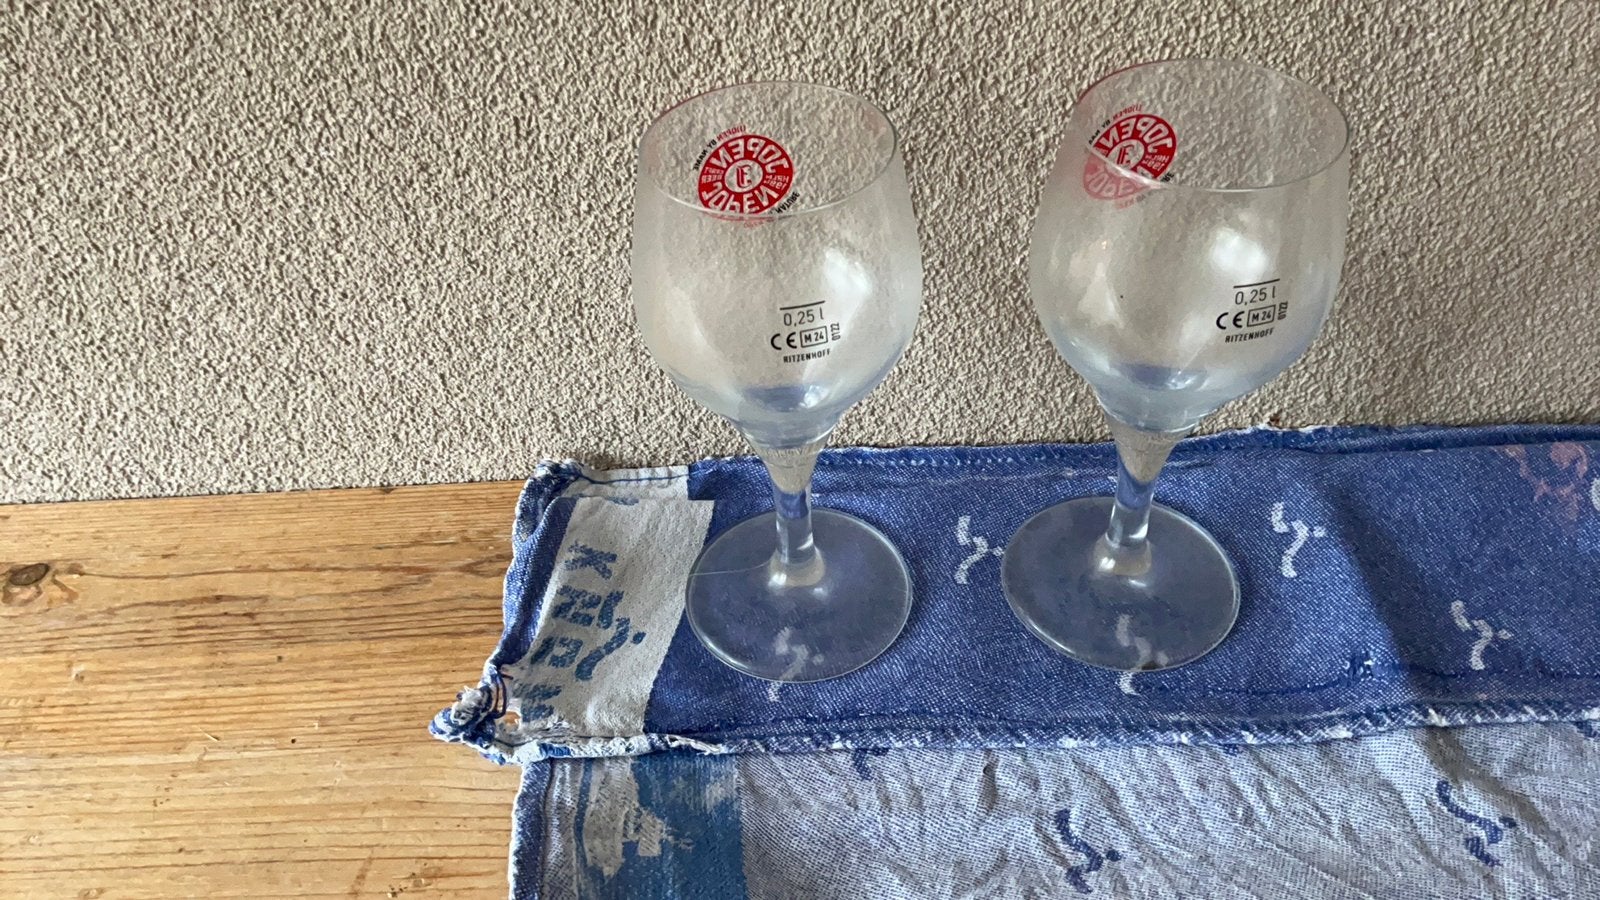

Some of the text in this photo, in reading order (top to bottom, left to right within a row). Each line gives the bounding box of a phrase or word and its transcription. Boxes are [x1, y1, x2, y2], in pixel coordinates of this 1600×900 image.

[1234, 287, 1267, 306] 0,25
[783, 309, 815, 327] 0,25
[1216, 310, 1245, 330] CE
[770, 331, 798, 350] CE
[1225, 327, 1275, 343] RITZENHOFF
[783, 348, 831, 363] RITZENHOFF
